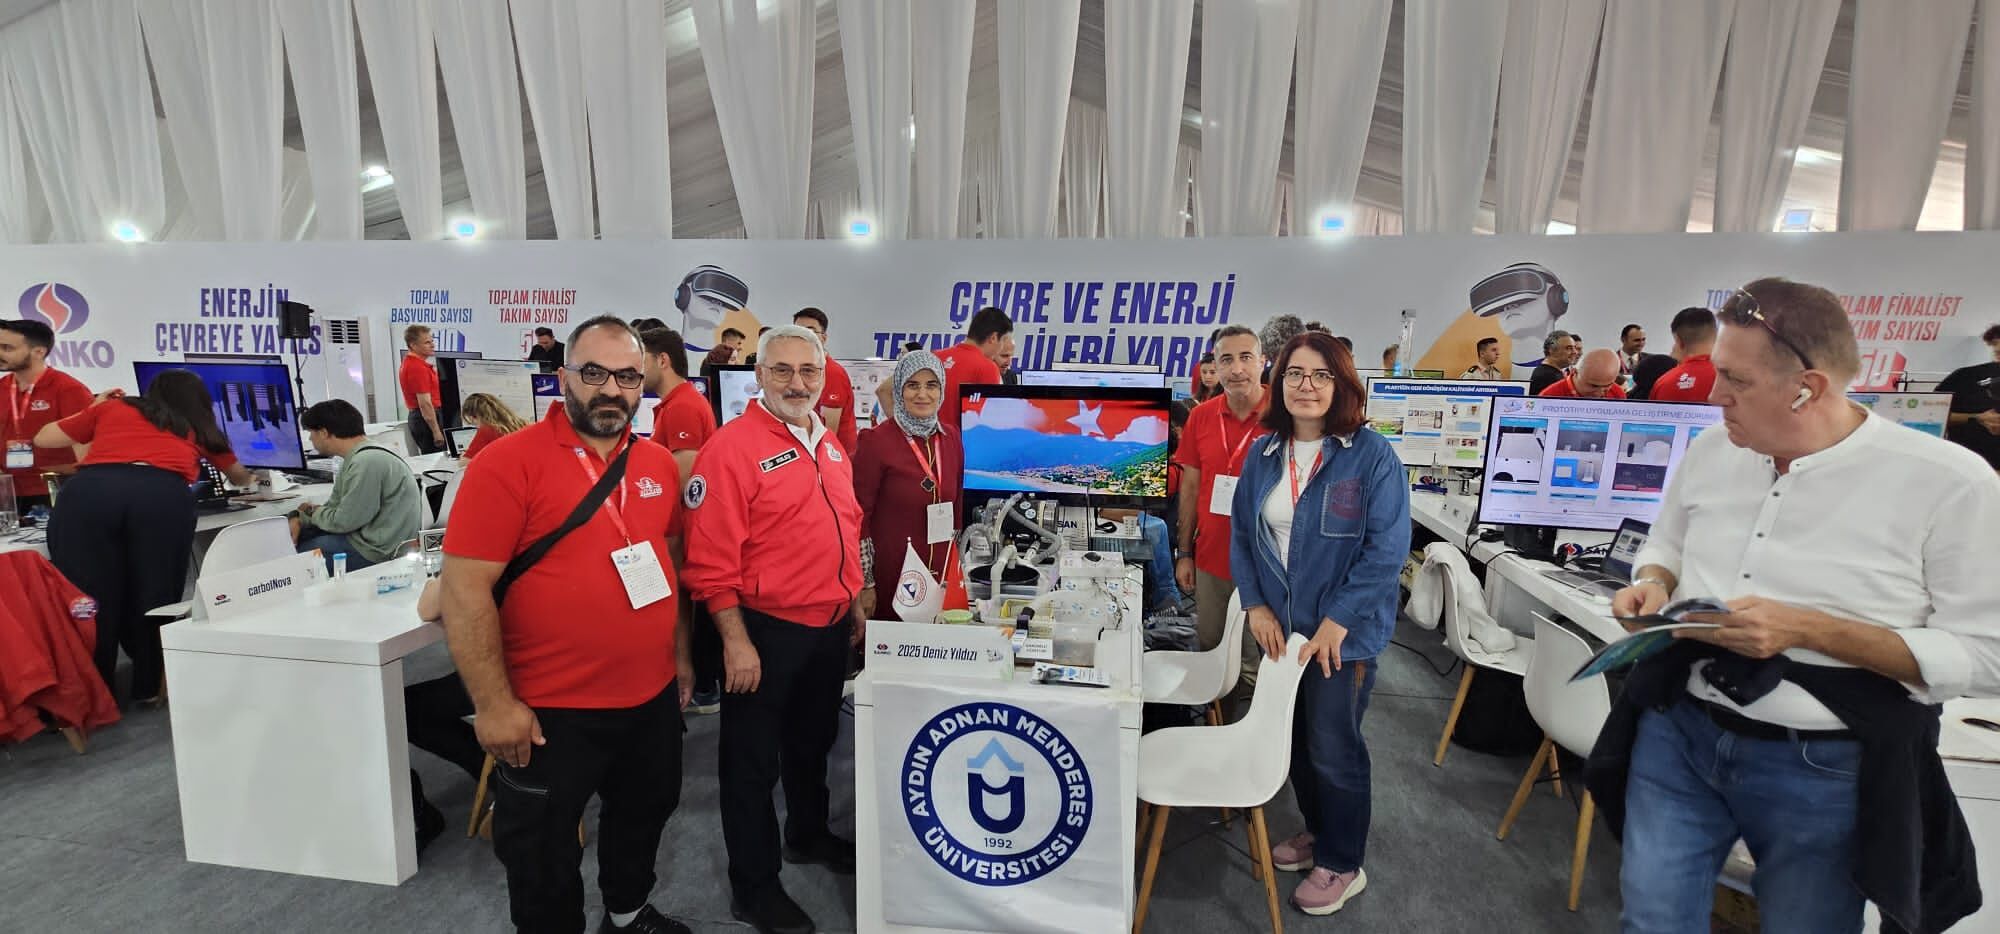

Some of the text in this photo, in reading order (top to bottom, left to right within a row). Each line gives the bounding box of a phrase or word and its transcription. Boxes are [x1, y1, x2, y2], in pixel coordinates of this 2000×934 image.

[410, 289, 449, 304] TOPLAM
[488, 287, 577, 305] TOPLAM FİNALİST
[949, 274, 1235, 330] ÇEVRE VE ENERJİ
[1886, 292, 1964, 316] FİNALİST
[391, 308, 472, 324] BAŞVURU SAYISI
[500, 308, 568, 323] TAKIM SAYISI
[156, 323, 243, 356] ÇEVREYE
[1883, 320, 1941, 341] SAYISI
[898, 644, 920, 658] 2025
[922, 645, 947, 659] Deniz
[950, 647, 977, 661] Yıldızı
[908, 707, 1086, 829] AYDIN ADNAN MENDERES
[983, 837, 1013, 849] 1992
[924, 825, 1074, 881] ÜNİVERSİTESİ
